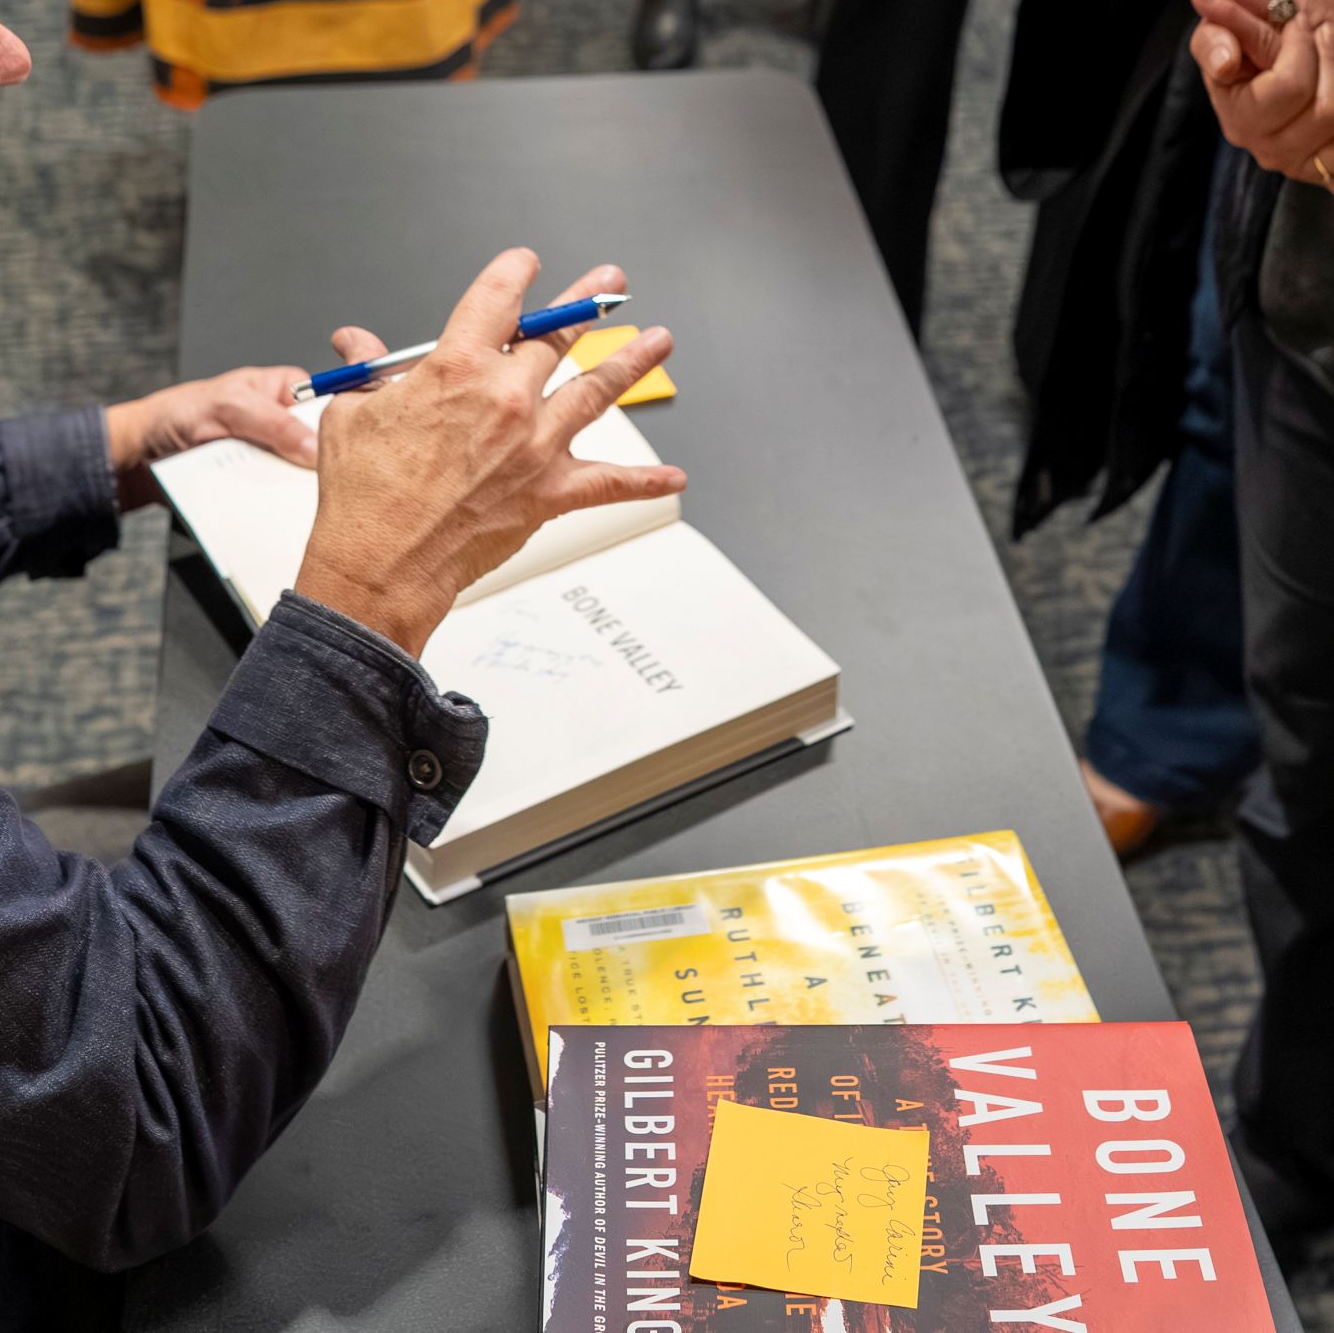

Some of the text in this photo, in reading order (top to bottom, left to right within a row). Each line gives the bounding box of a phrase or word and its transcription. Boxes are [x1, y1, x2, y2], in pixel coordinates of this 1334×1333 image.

[561, 585, 619, 636] BONE
[609, 628, 684, 695] VALLEY
[593, 948, 612, 1011] OLENCE,
[720, 907, 777, 1024] RUTHL
[805, 976, 829, 990] A
[841, 902, 907, 1024] BENEAT
[594, 1041, 606, 1086] PULITZER
[830, 1075, 861, 1101] OF
[895, 1099, 924, 1112] A
[594, 1090, 606, 1169] PRIZE-WINNING
[594, 1171, 606, 1215] AUTHOR
[623, 1049, 682, 1333] GILBERT KING
[949, 1046, 1088, 1333] VALLEY
[1082, 1089, 1217, 1283] BONE
[594, 1218, 606, 1233] OF
[594, 1236, 606, 1269] DEVIL
[594, 1272, 606, 1286] IN
[594, 1289, 606, 1312] THE
